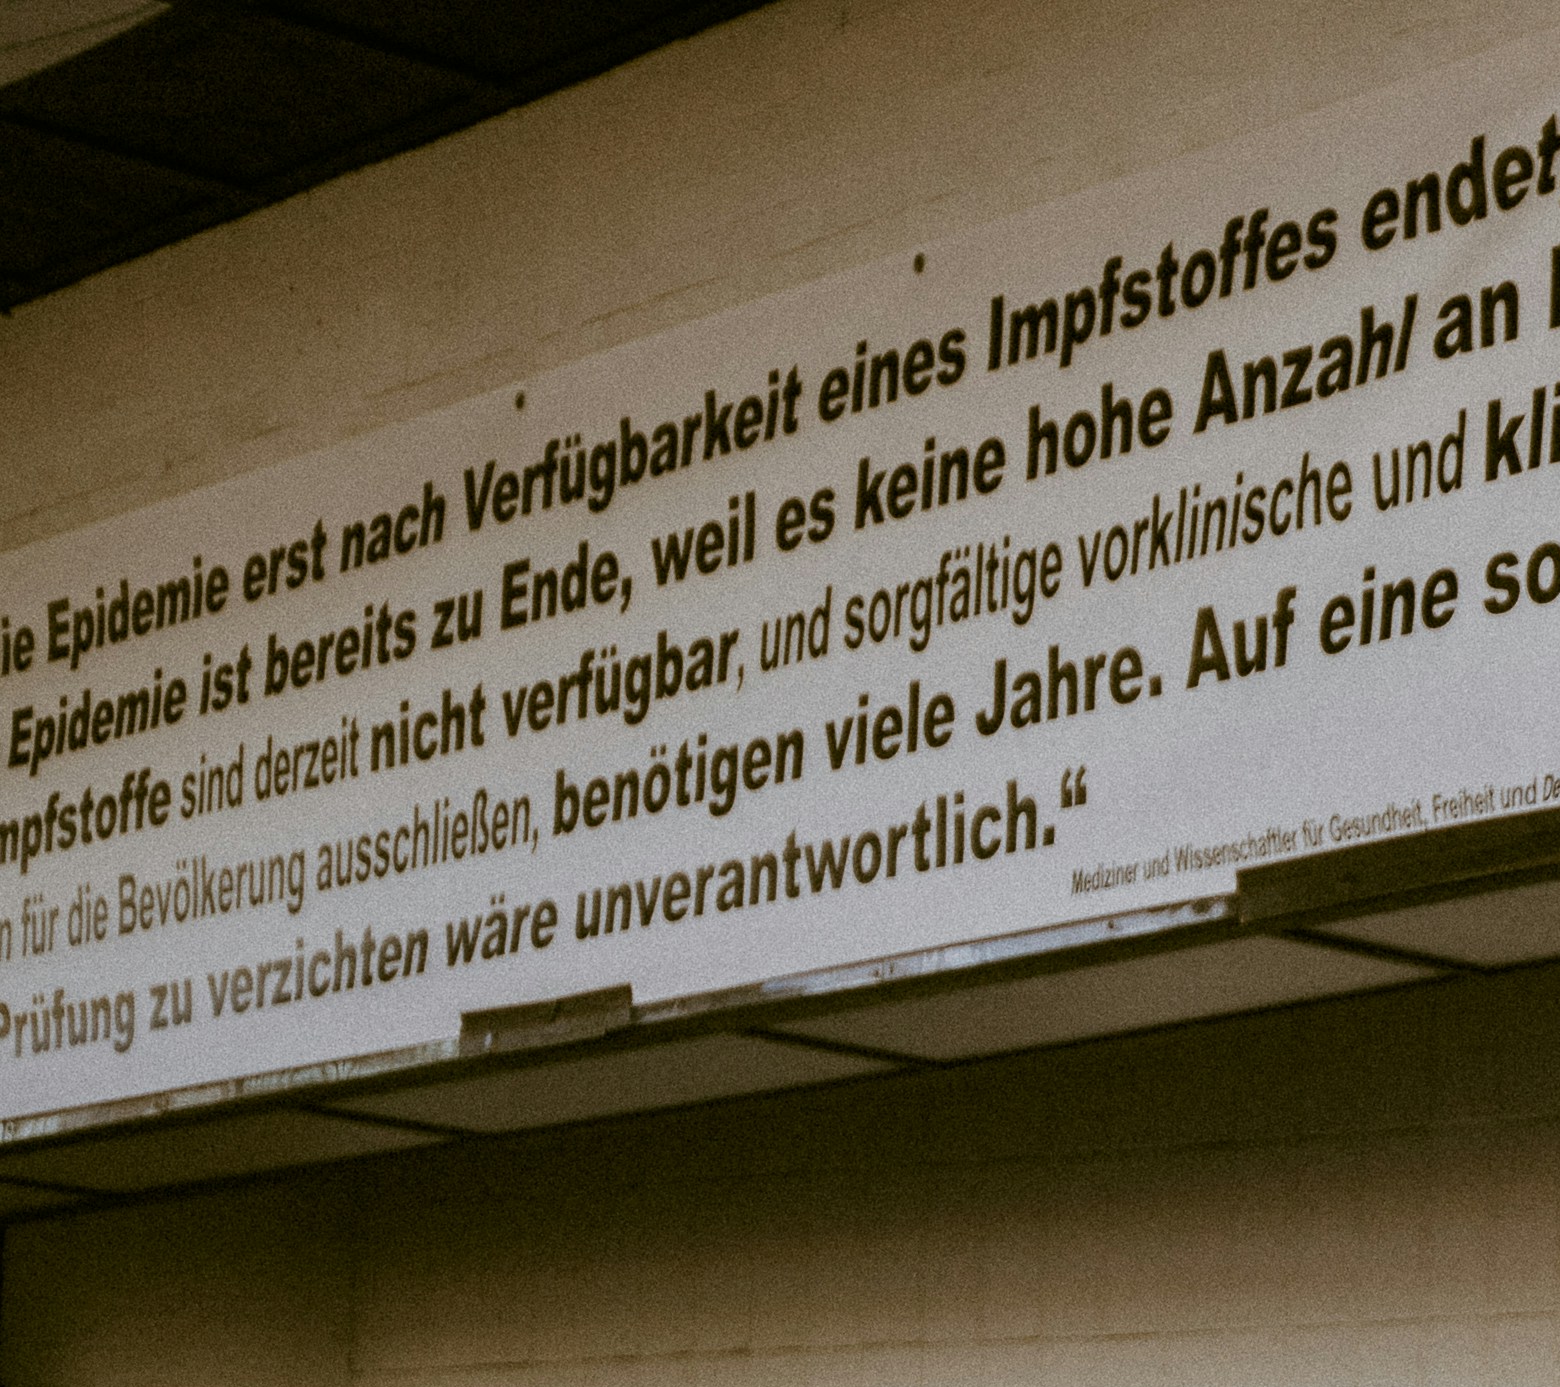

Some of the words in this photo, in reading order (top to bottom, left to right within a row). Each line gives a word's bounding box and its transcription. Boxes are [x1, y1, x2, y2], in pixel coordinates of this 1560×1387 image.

[8, 679, 188, 776] Epidemie
[200, 648, 253, 714] ist
[264, 606, 417, 696] bereits
[431, 591, 483, 650] zu
[500, 542, 633, 630] Ende,
[651, 492, 756, 586] weil
[775, 488, 836, 553] es
[854, 437, 1007, 530] keine
[1026, 383, 1174, 481] hohe
[1194, 294, 1419, 434] Anzahl
[1433, 281, 1520, 360] an
[47, 566, 230, 670] Epidemie
[242, 523, 328, 603] erst
[340, 483, 447, 572] nach
[464, 369, 803, 531] Verfügbarkeit
[818, 328, 967, 423] eines
[987, 208, 1338, 372] Impfstoffes
[150, 984, 193, 1030] zu
[210, 929, 430, 1016] verzichten
[445, 899, 559, 968] wäre
